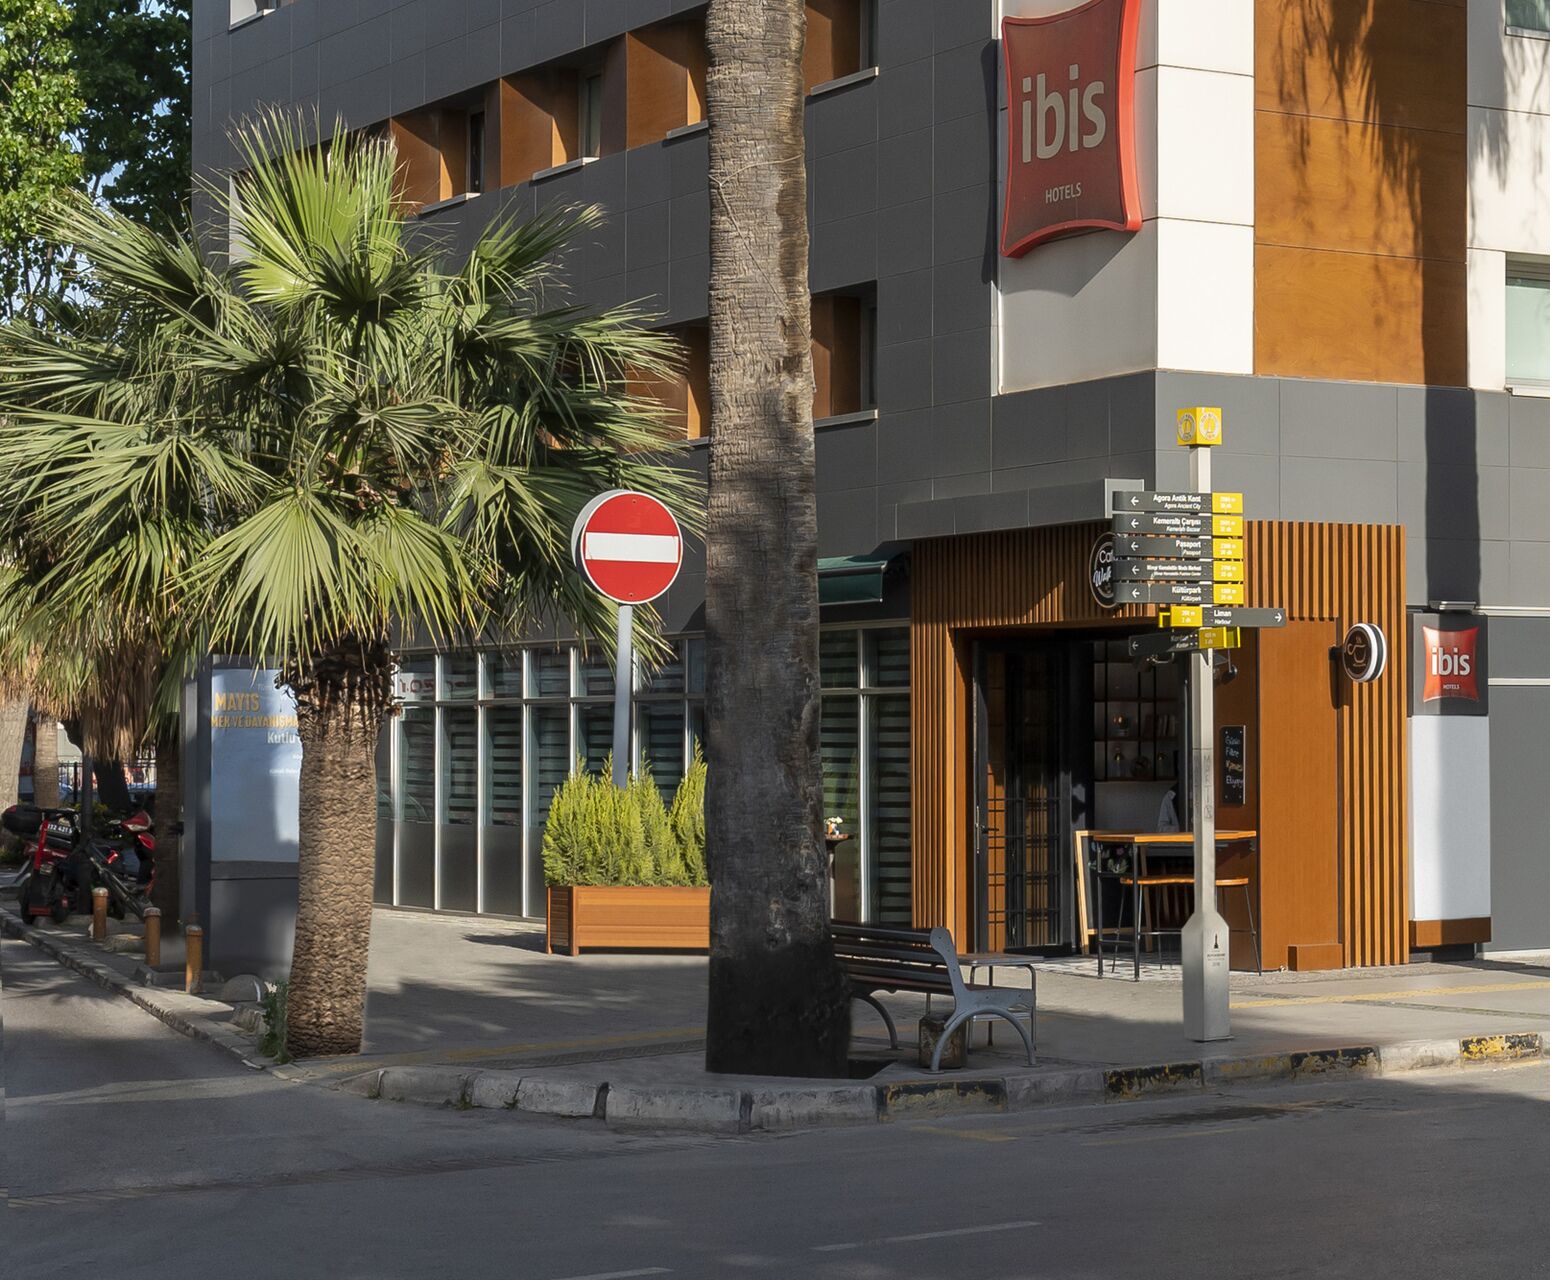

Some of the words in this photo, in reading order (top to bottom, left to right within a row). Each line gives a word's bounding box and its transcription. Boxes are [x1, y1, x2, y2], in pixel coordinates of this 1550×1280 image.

[1022, 64, 1106, 164] ibis
[1045, 182, 1082, 204] HOTELS
[1153, 494, 1170, 503] Agora
[1214, 609, 1232, 617] Liman
[1431, 646, 1471, 676] ibis
[214, 692, 260, 711] MAYIS
[267, 731, 296, 744] Kutlu
